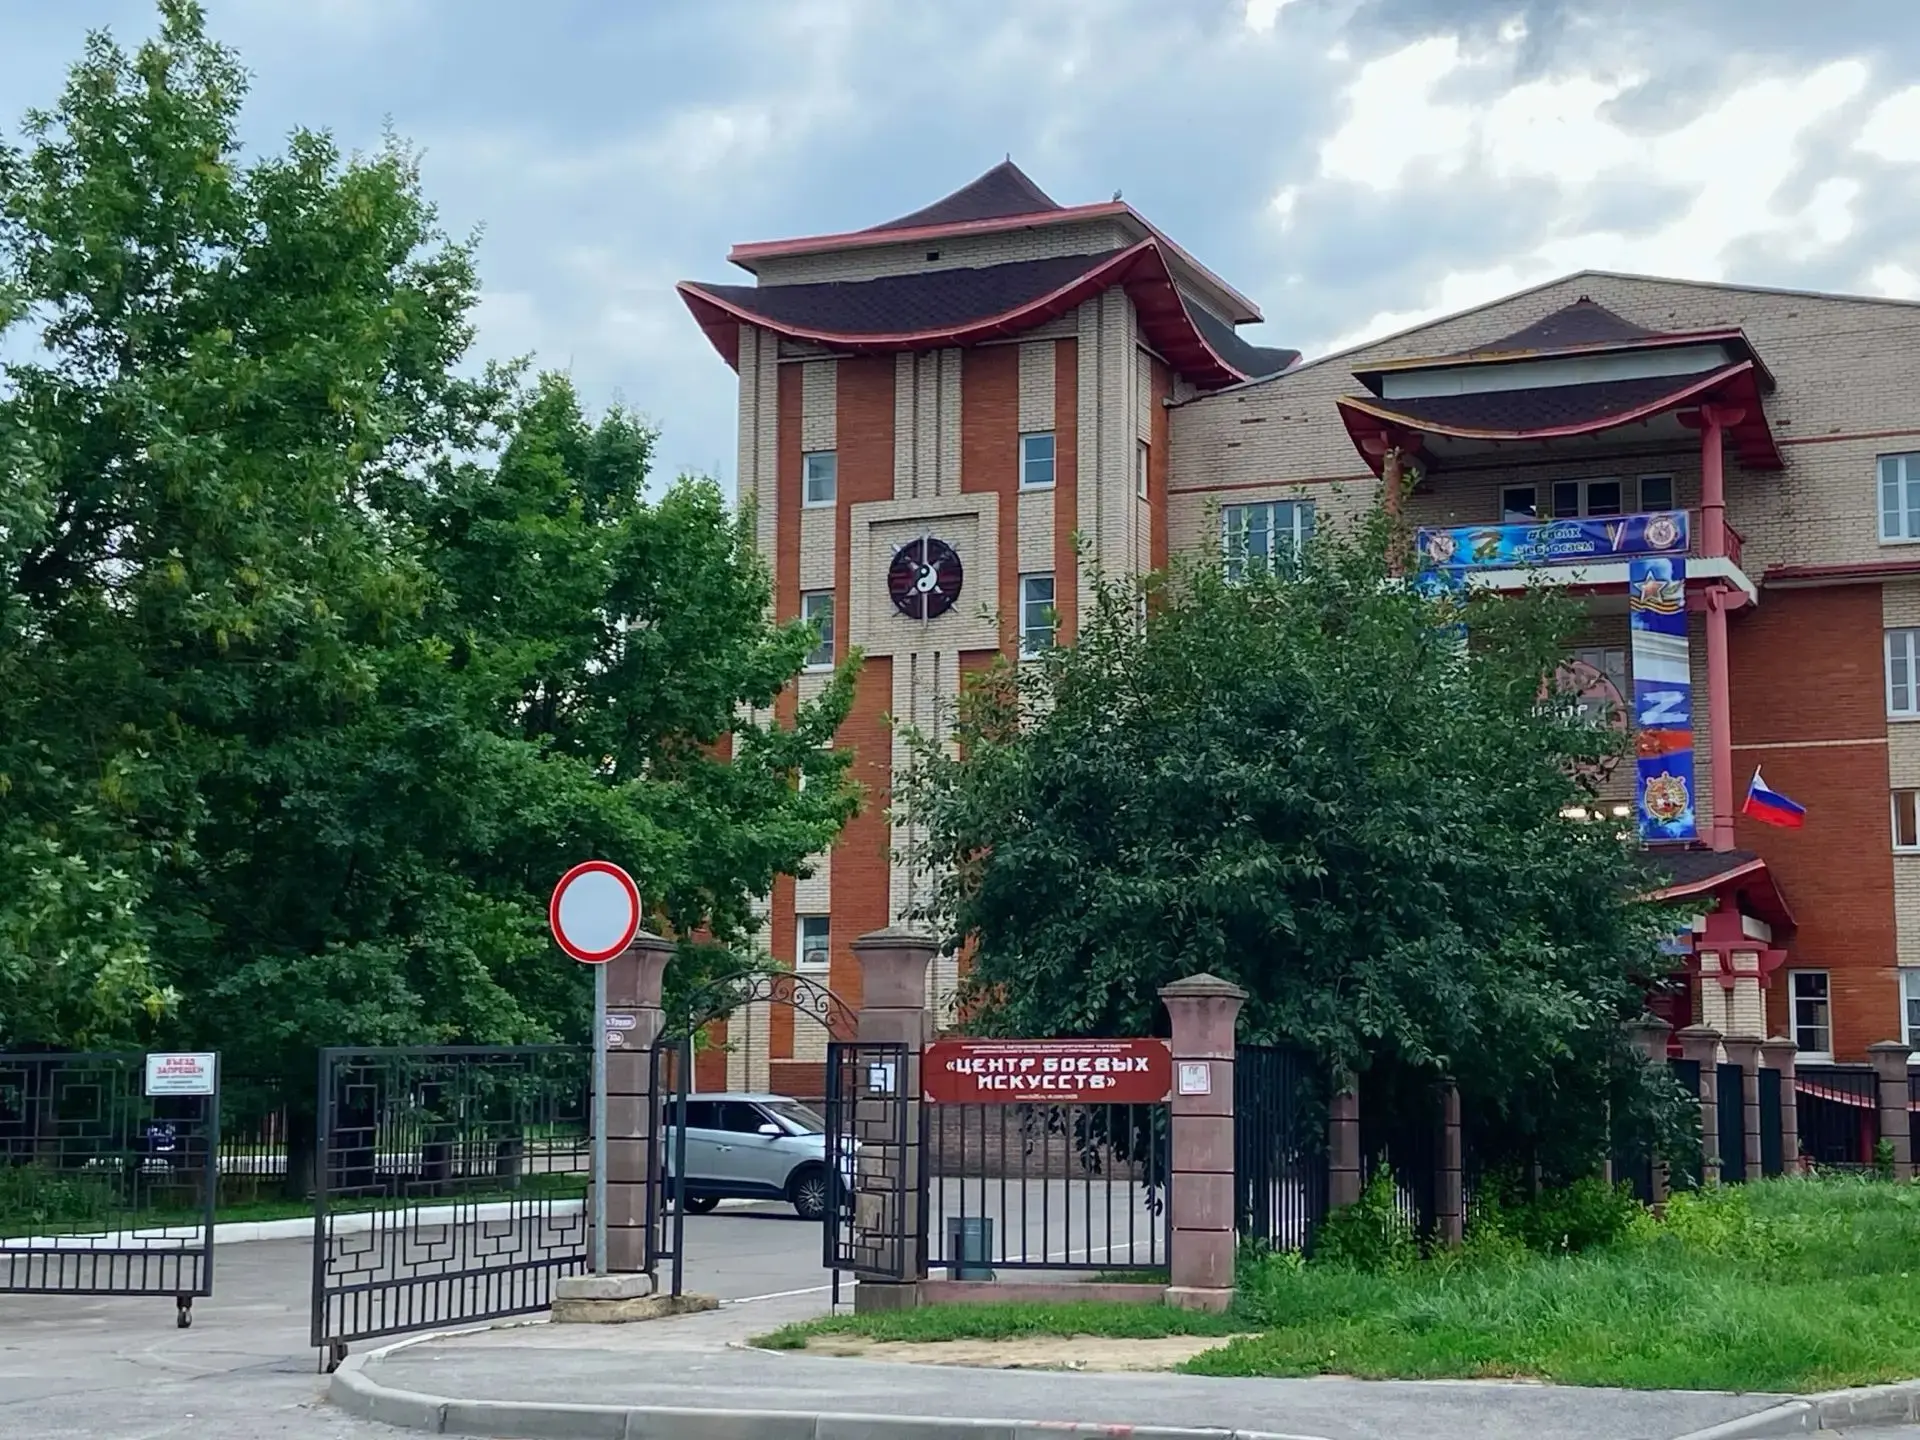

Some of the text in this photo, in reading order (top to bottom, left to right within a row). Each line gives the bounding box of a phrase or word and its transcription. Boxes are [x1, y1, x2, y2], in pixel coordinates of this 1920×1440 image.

[946, 1057, 1149, 1074] «ЦЕНТР БОЕВЫХ
[977, 1075, 1117, 1090] ИСКУССТВ»
